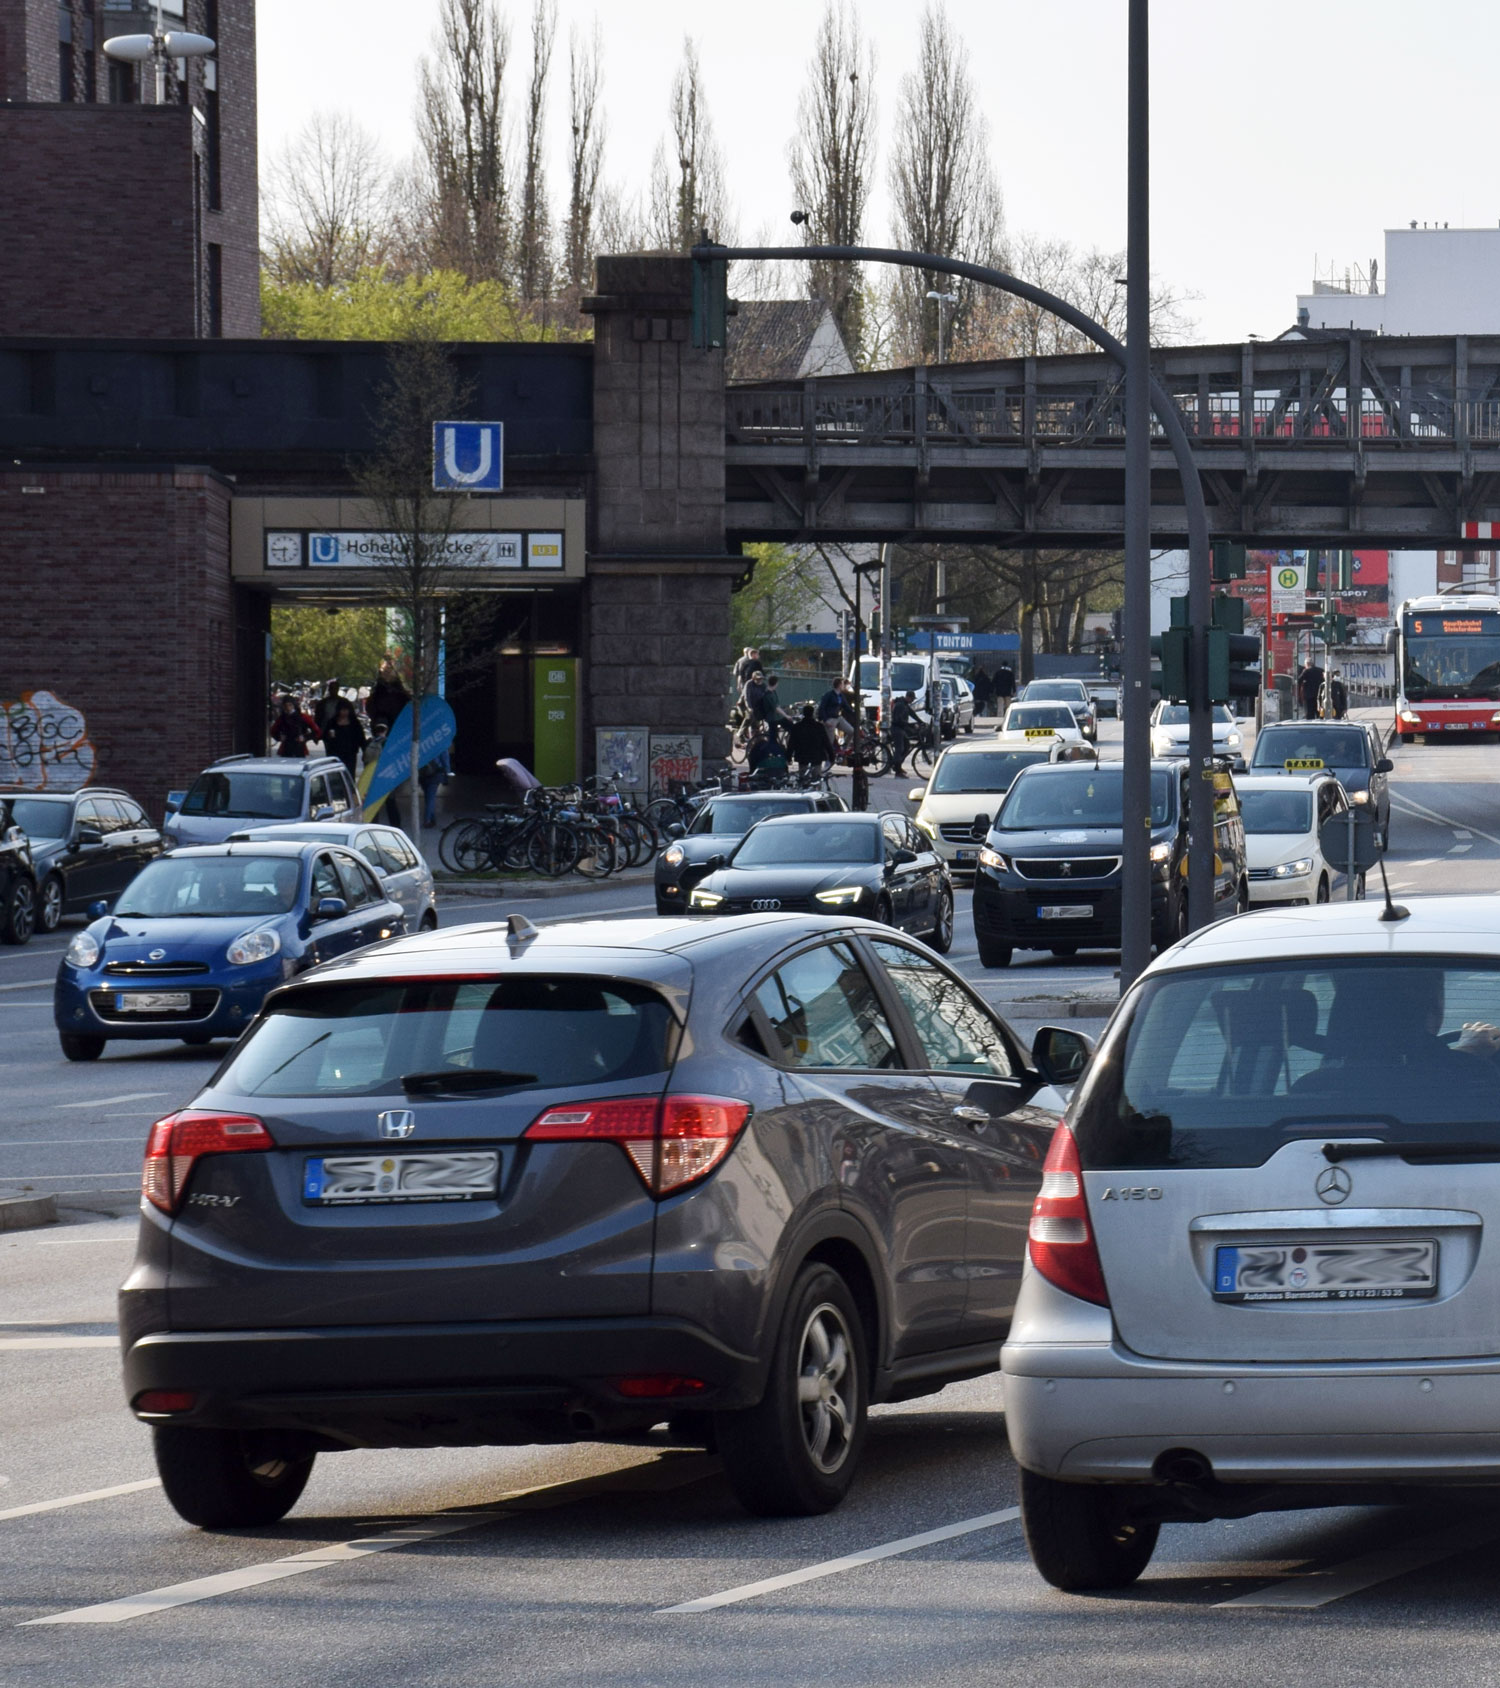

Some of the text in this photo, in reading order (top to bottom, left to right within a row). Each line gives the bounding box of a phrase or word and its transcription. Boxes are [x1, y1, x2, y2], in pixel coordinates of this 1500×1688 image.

[444, 427, 492, 483] U
[937, 636, 973, 648] TONTON
[1341, 663, 1386, 678] TONTON
[1290, 760, 1318, 768] TAXI
